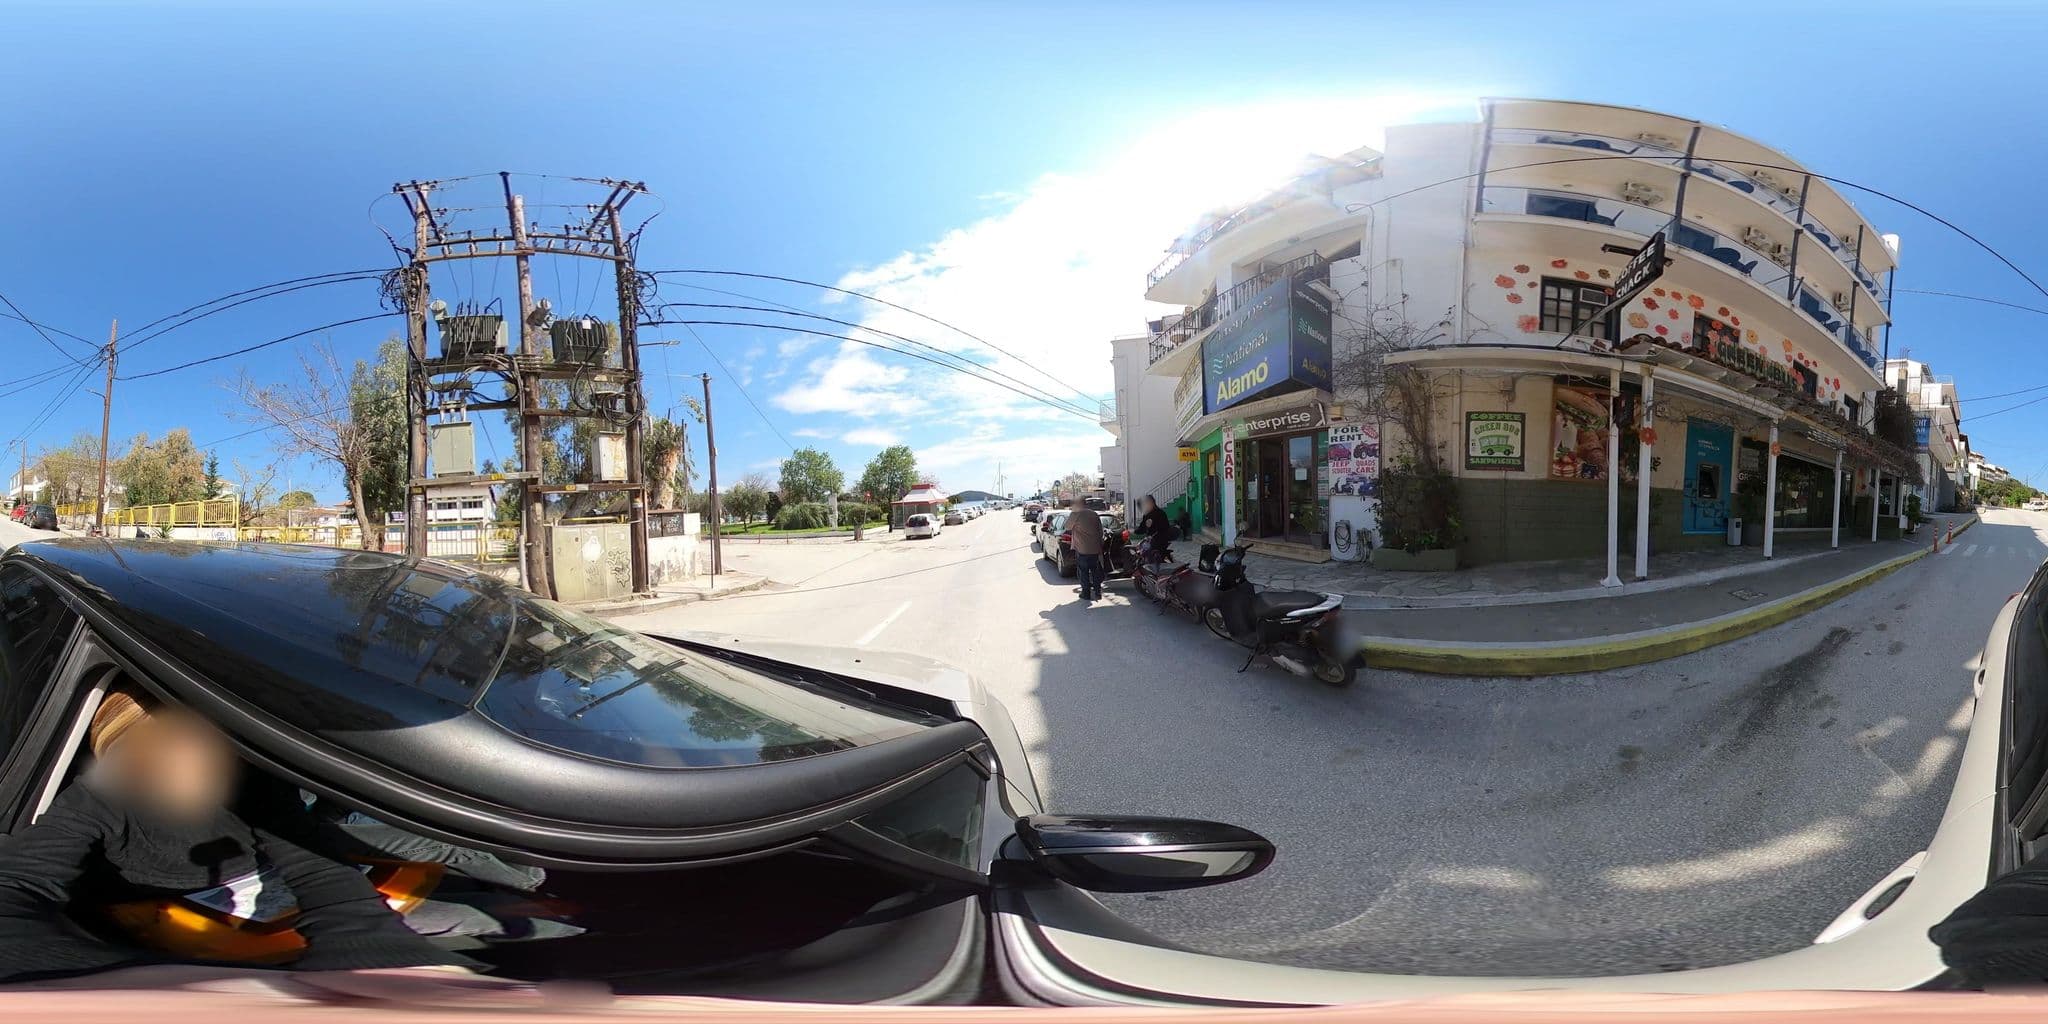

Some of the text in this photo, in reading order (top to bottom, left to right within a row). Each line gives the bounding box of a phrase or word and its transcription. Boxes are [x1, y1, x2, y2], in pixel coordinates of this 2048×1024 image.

[1616, 242, 1656, 284] COFFEE
[1225, 330, 1269, 368] National
[1301, 357, 1328, 380] Alamo
[1216, 361, 1268, 405] Alamo
[1233, 412, 1311, 433] enterprise
[1334, 426, 1359, 435] FOR
[1474, 422, 1501, 435] GREEN
[1330, 434, 1364, 443] RENT
[1182, 451, 1197, 459] ATM
[1223, 440, 1234, 480] CAR
[1356, 466, 1376, 474] CARS
